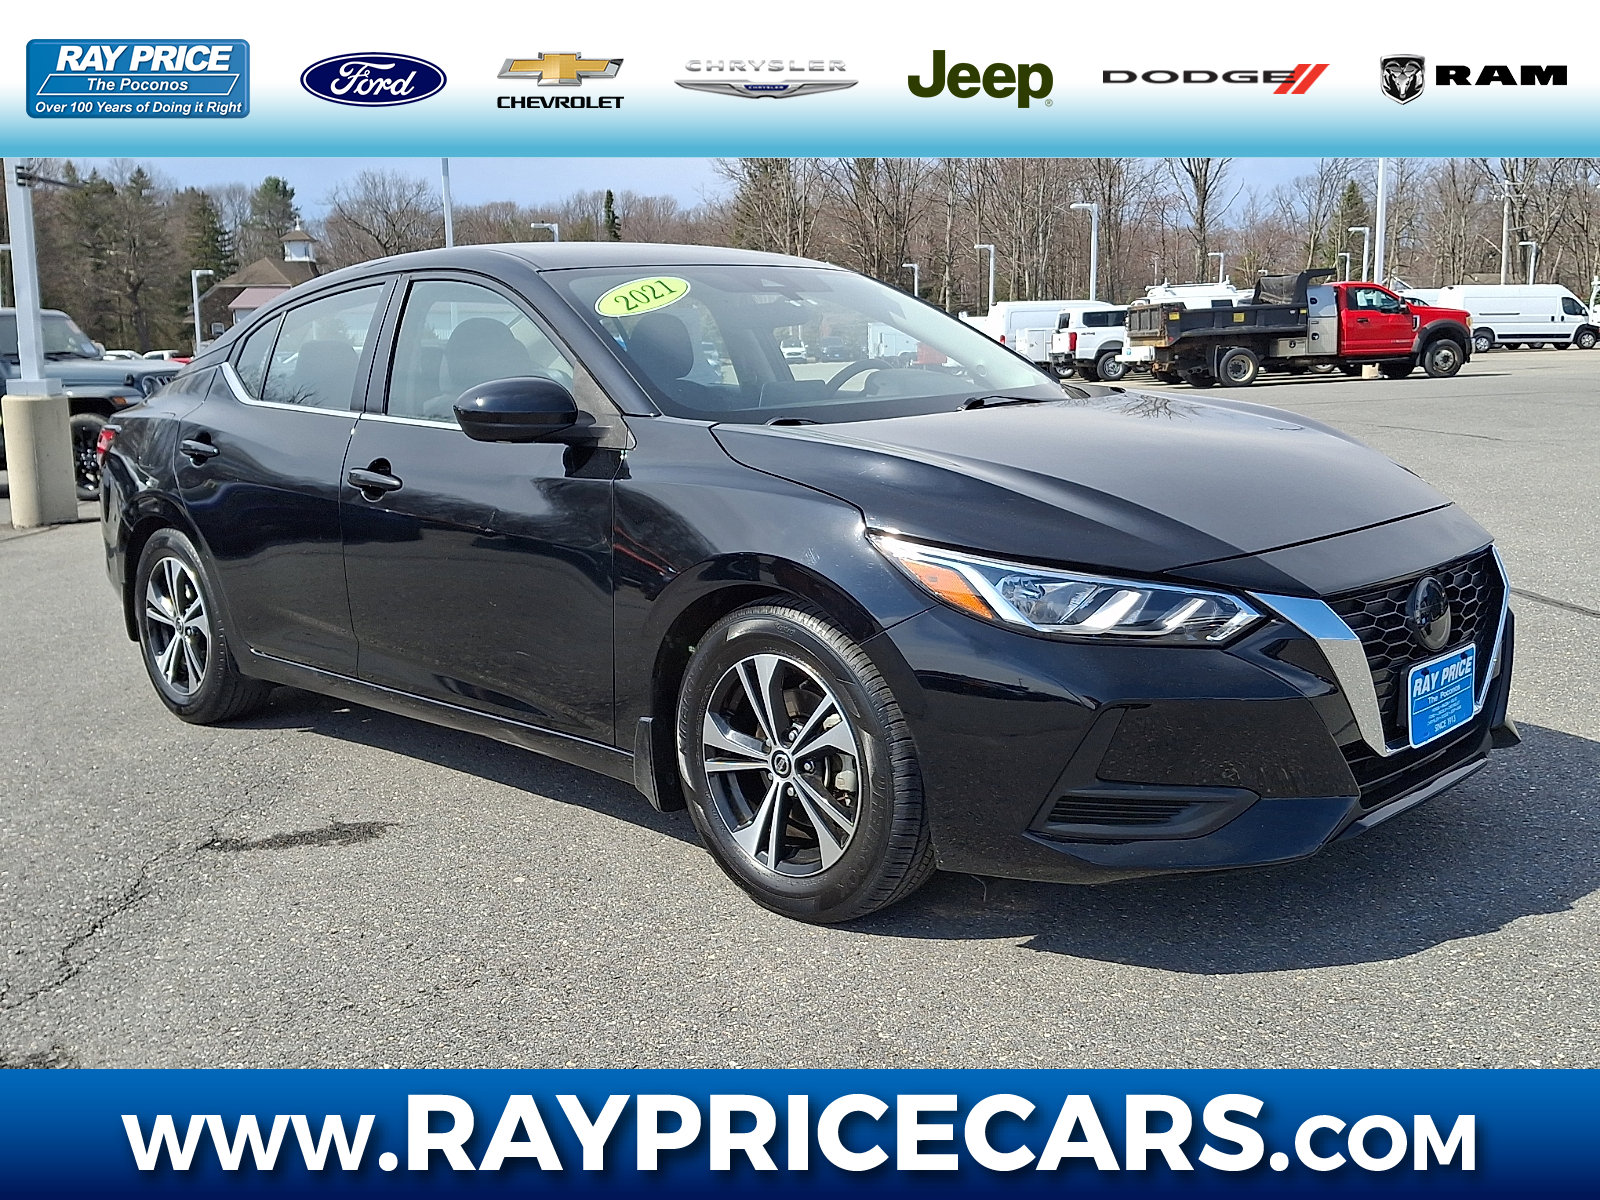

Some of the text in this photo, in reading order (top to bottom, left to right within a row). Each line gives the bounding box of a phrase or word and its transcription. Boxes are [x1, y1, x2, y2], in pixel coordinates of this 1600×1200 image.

[615, 280, 677, 311] 2021
[1413, 657, 1472, 697] RAY PRICE
